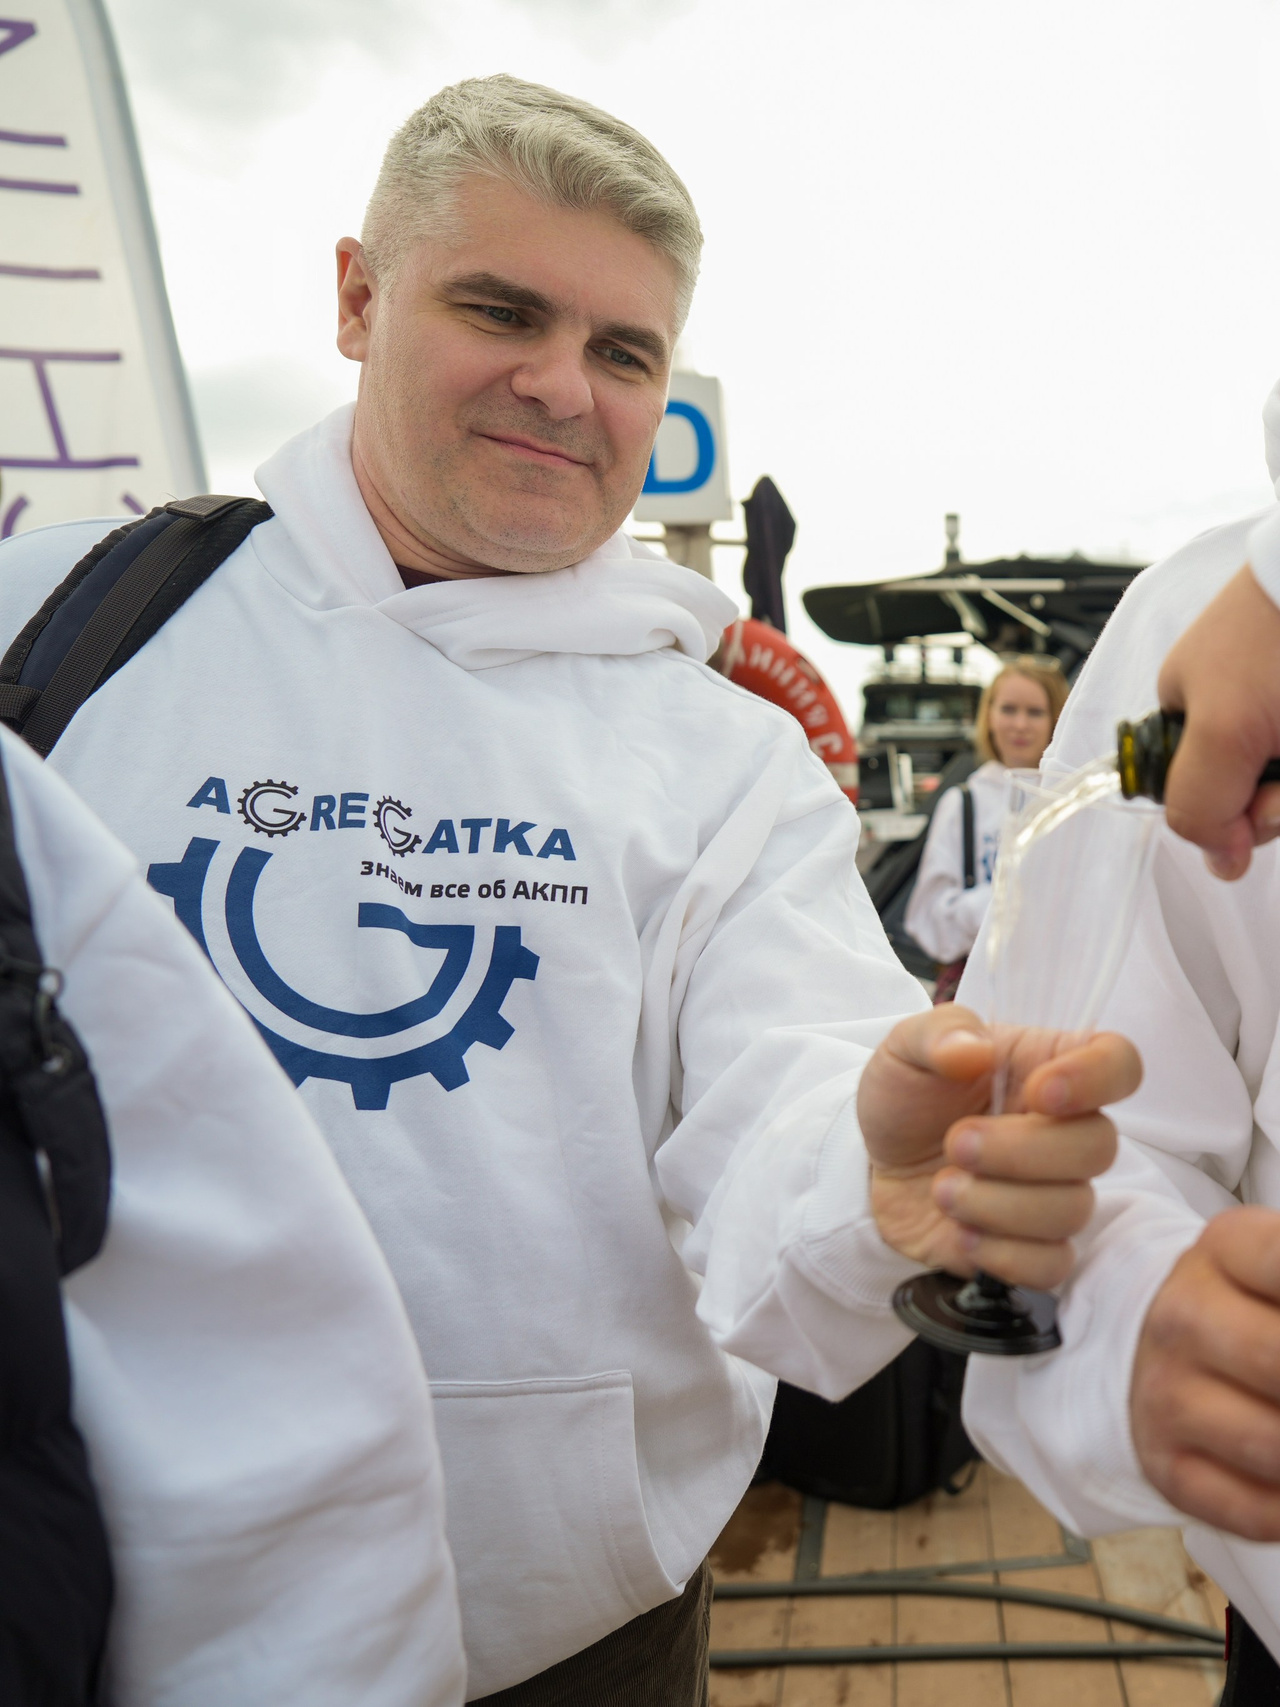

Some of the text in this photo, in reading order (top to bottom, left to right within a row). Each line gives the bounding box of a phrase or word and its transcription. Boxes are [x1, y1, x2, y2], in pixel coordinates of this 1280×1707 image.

[186, 776, 577, 861] AGREGATKA
[430, 883, 470, 899] все
[478, 879, 506, 899] об
[512, 880, 589, 905] АКПП
